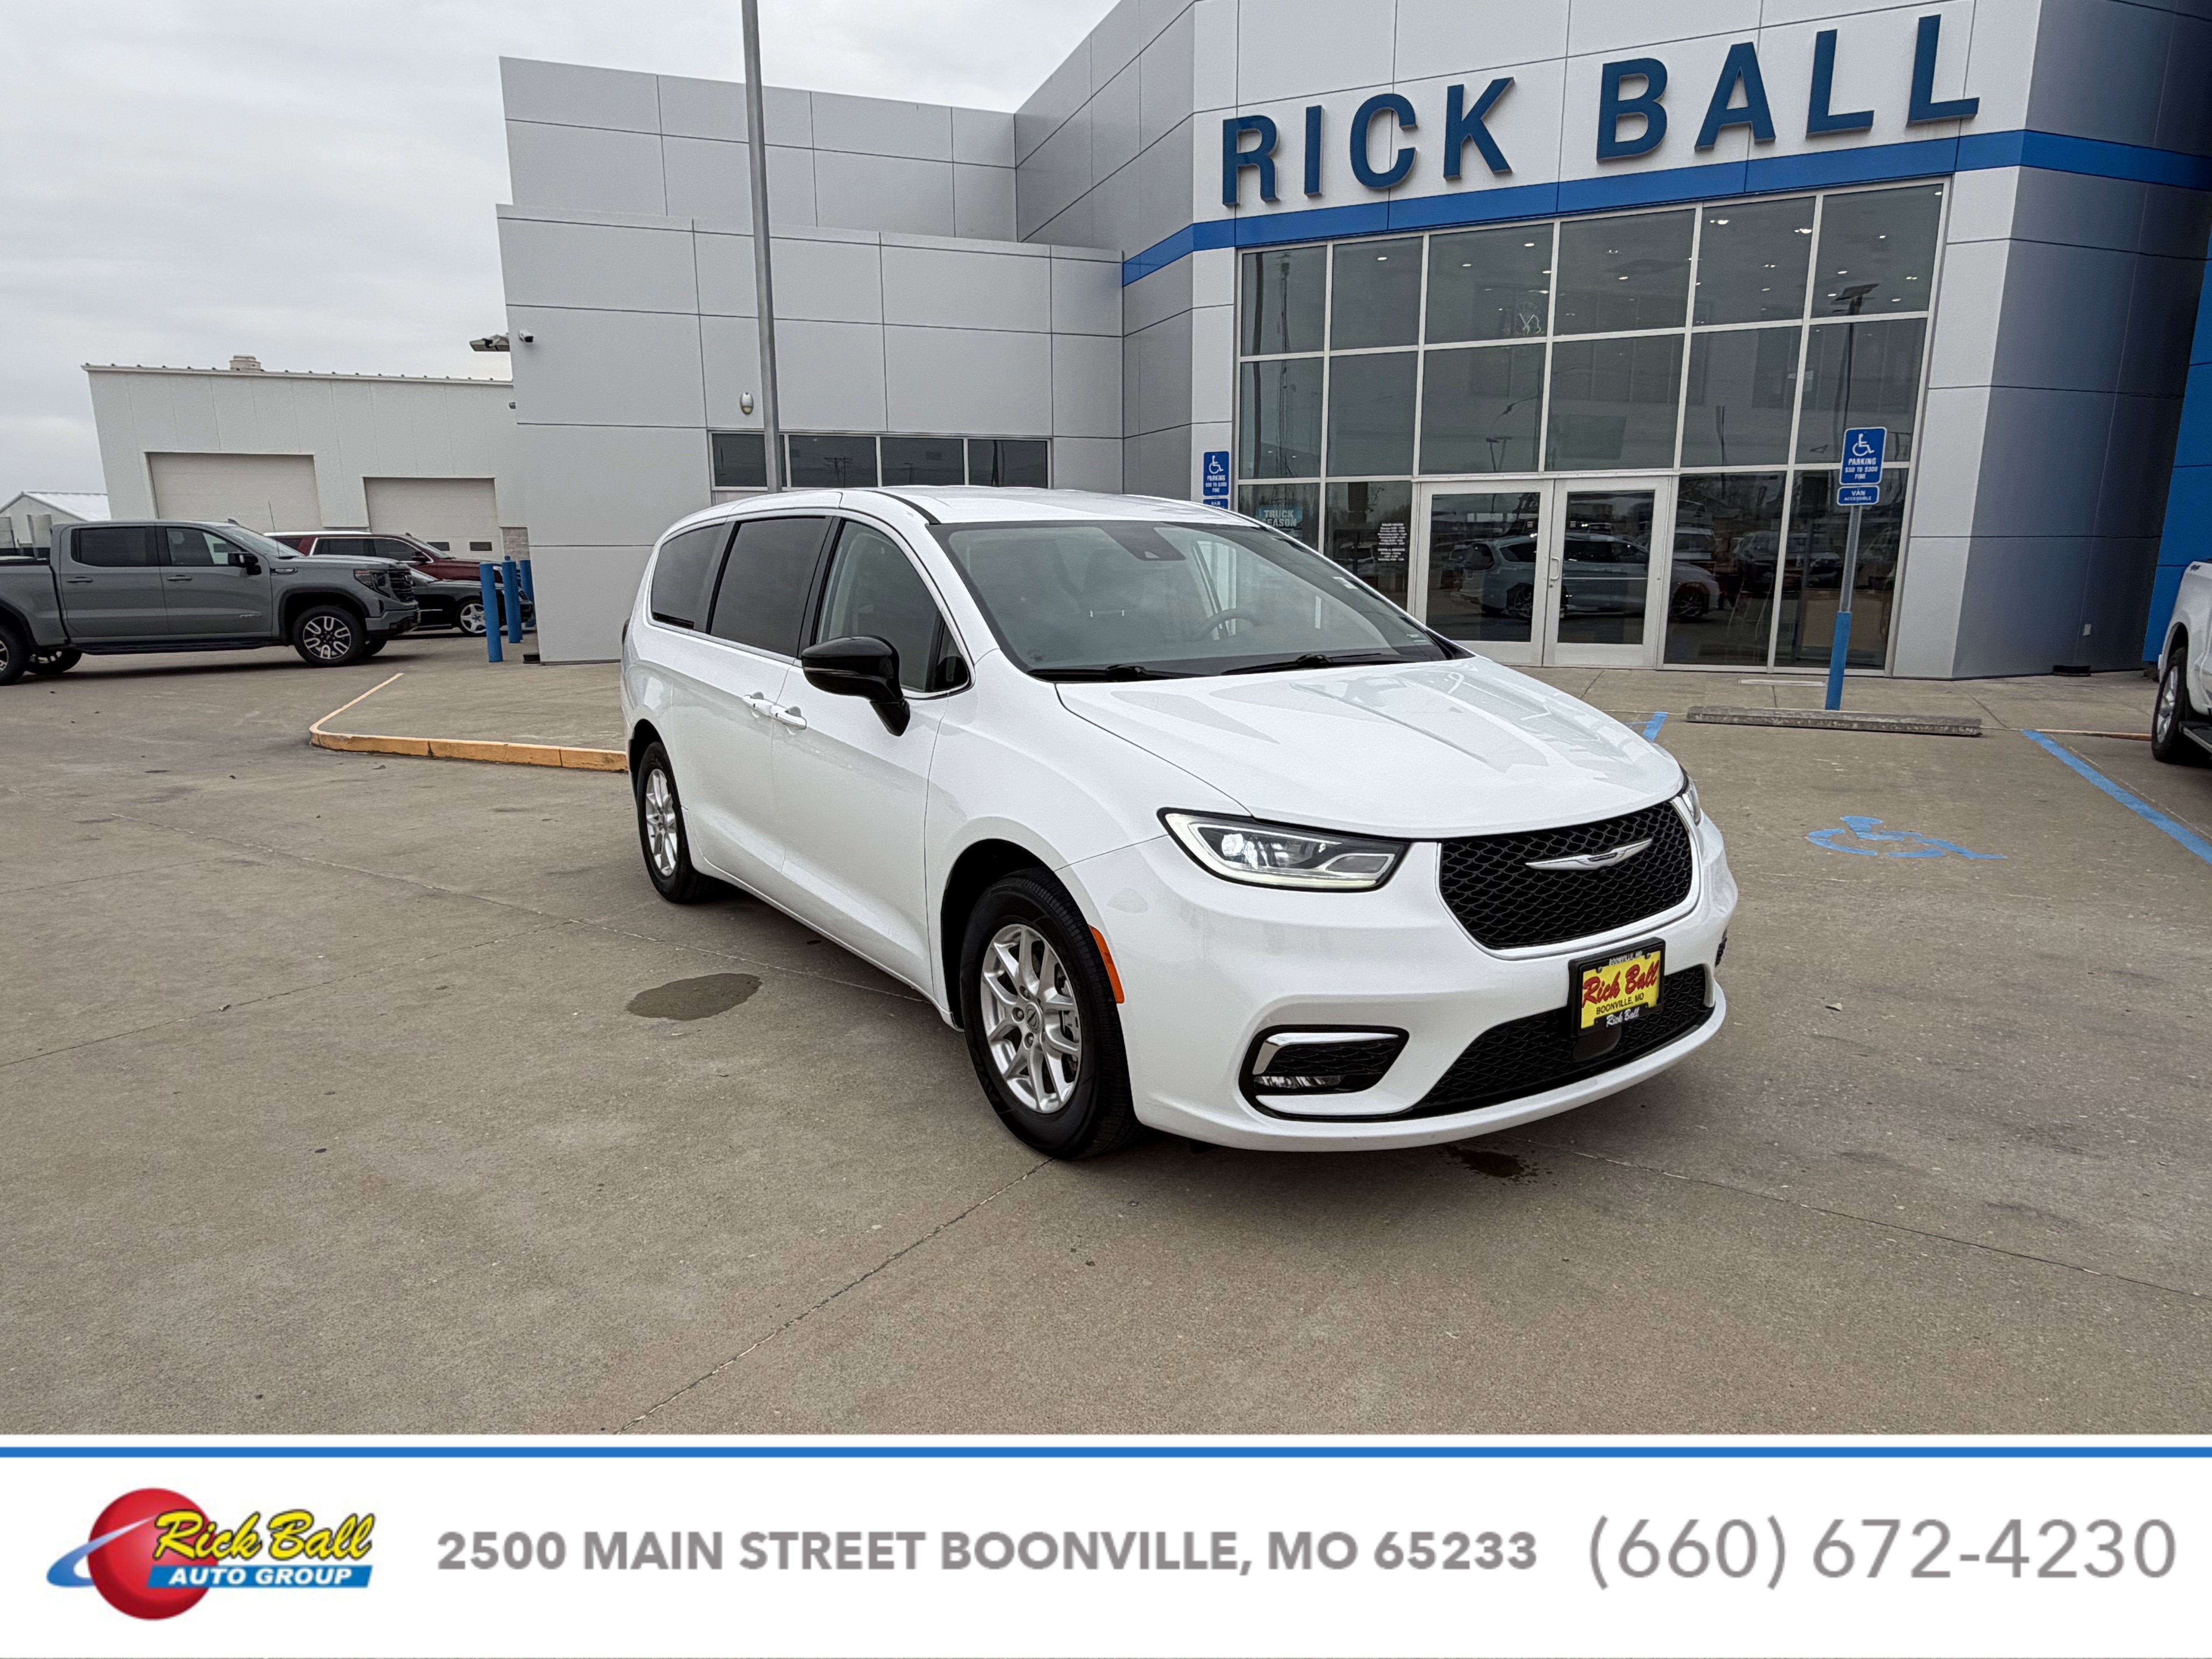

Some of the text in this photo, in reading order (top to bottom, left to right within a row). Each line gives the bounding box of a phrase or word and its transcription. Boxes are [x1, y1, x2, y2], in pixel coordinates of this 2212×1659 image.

[1222, 14, 1980, 207] RICK BALL
[1848, 457, 1877, 466] PARKING
[1264, 509, 1294, 519] TRUCK
[1582, 960, 1659, 1008] Rick Ball
[1635, 992, 1644, 1002] MO
